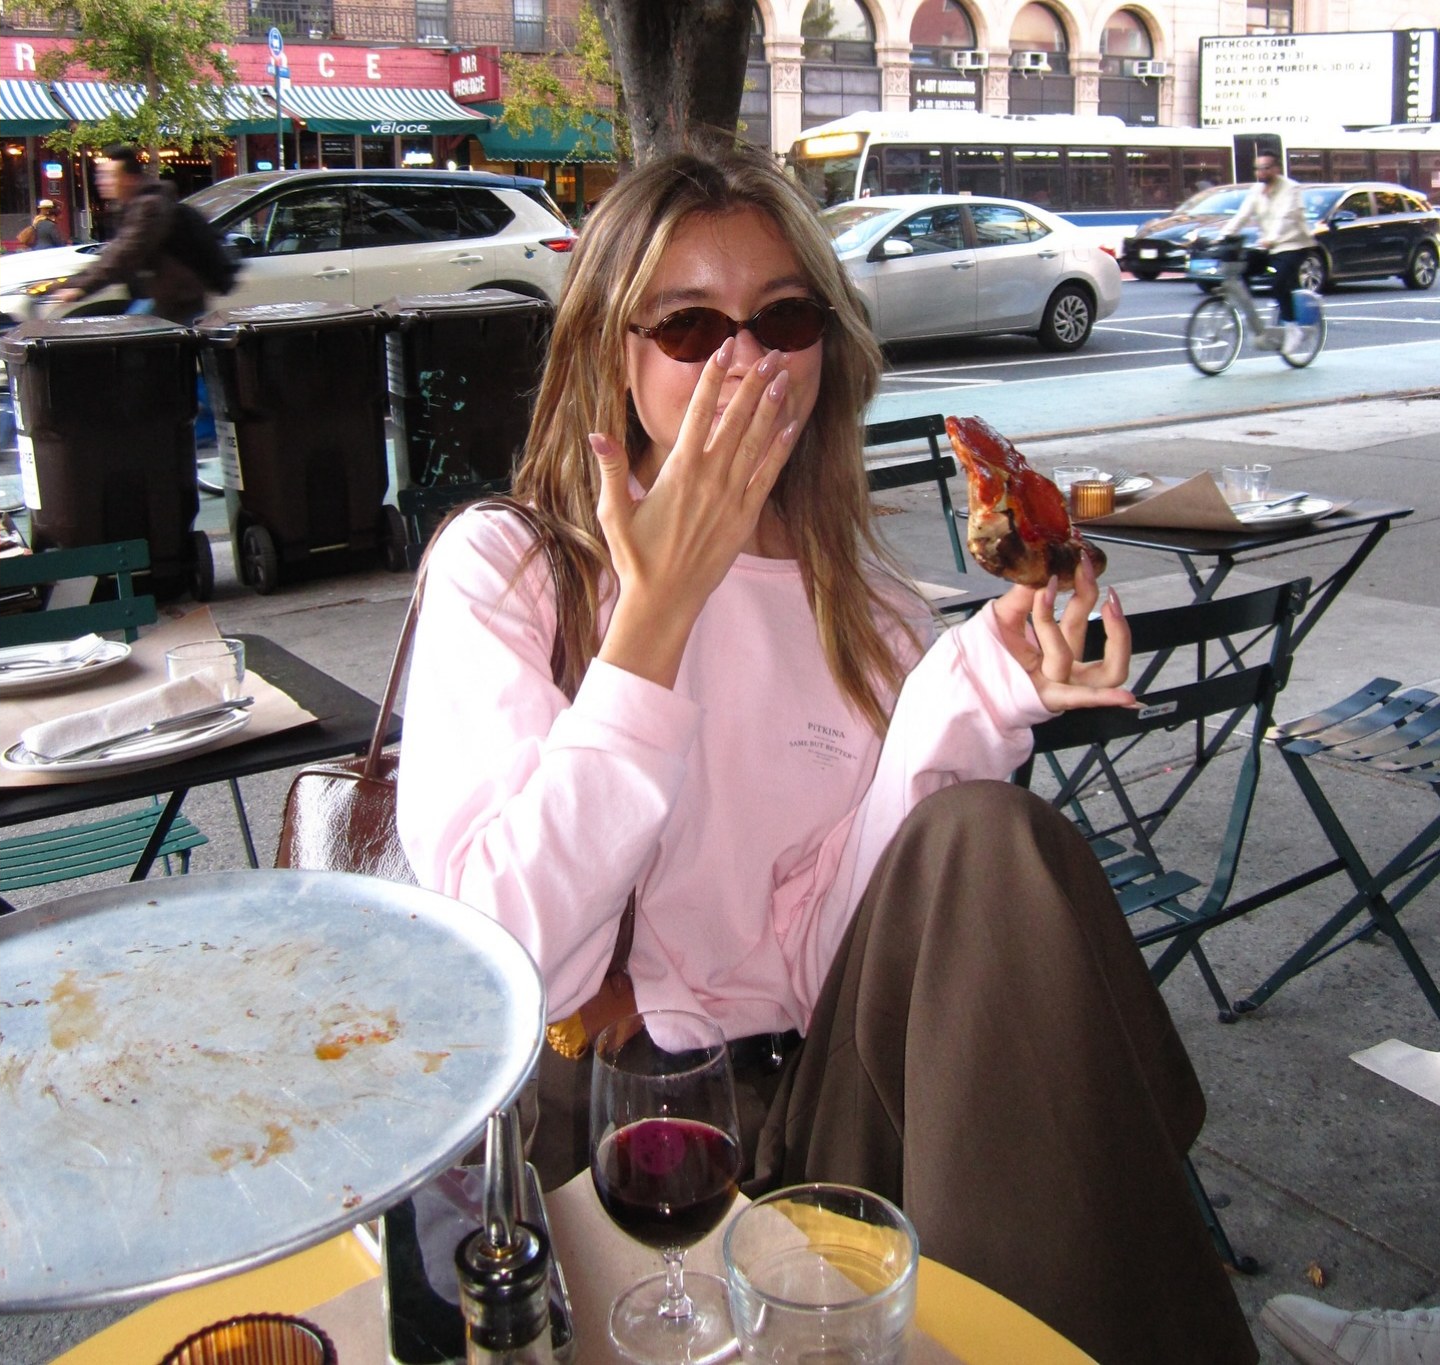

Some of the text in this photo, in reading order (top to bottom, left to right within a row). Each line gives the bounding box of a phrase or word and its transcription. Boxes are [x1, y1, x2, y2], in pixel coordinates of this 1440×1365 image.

[460, 54, 478, 74] BAR
[1277, 63, 1319, 72] MURDER
[371, 121, 431, 134] veloce
